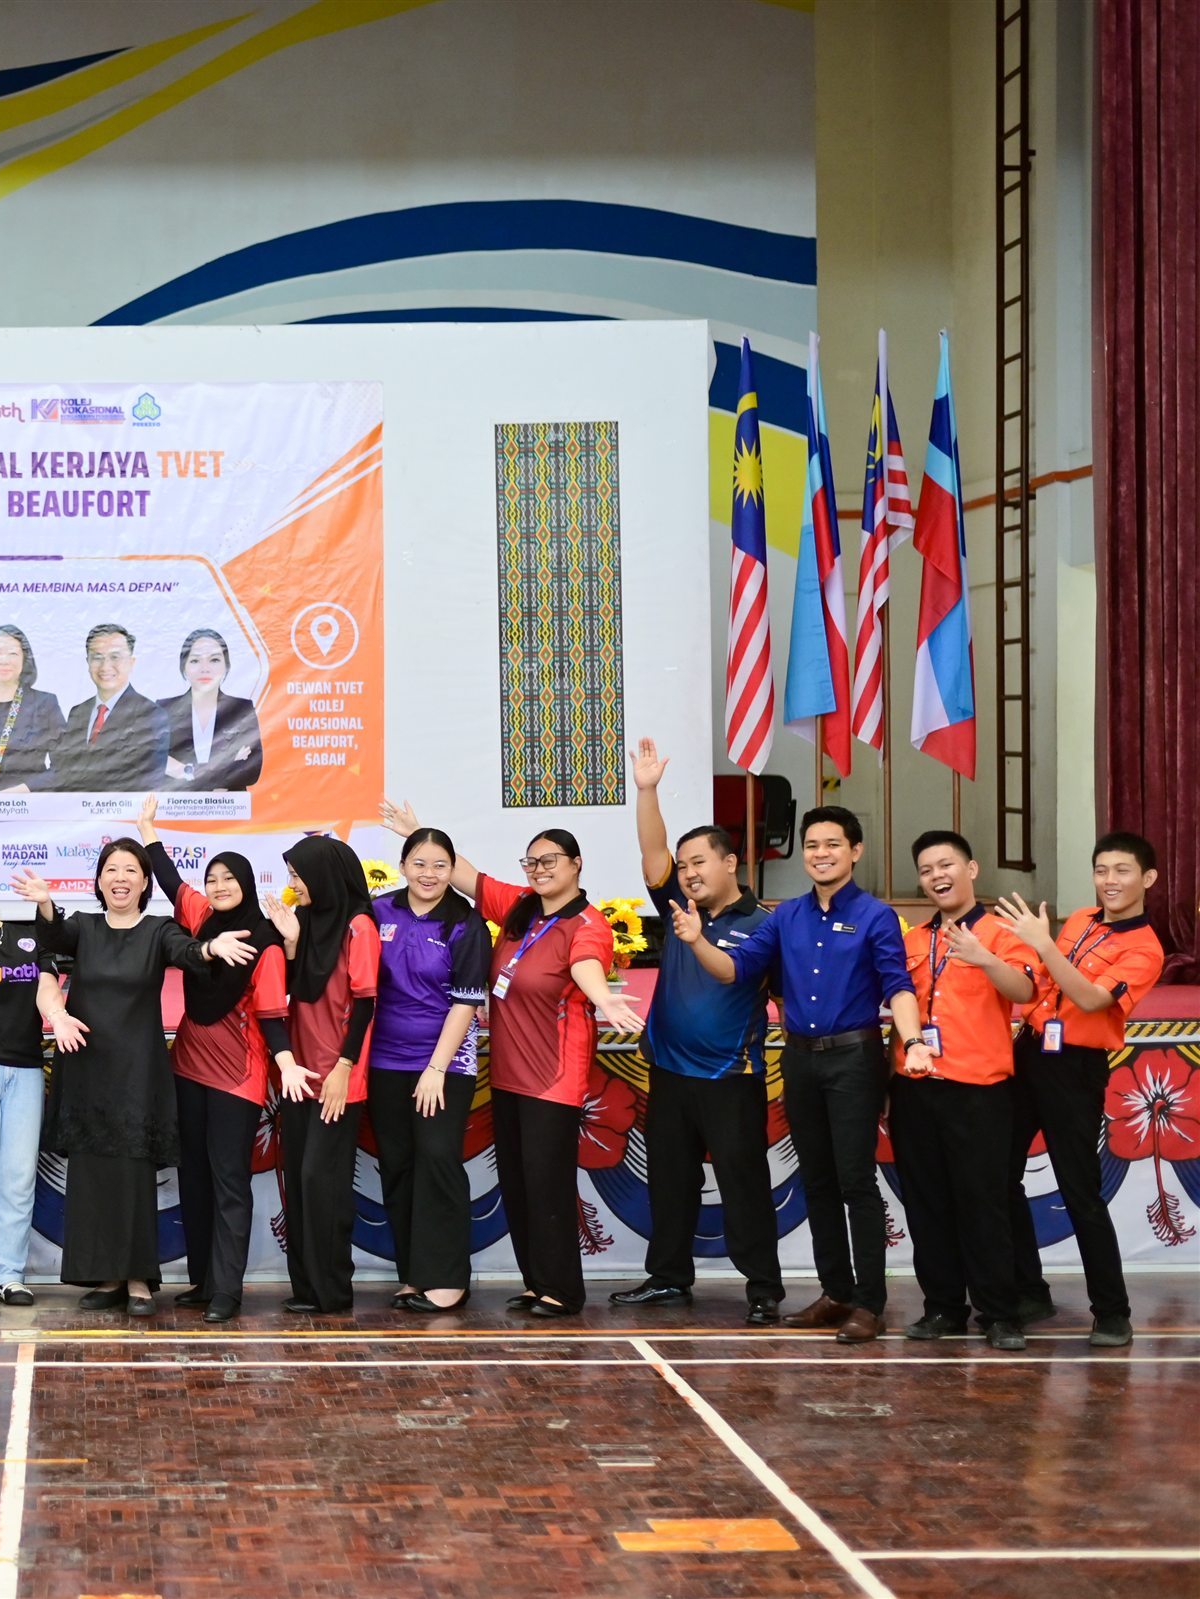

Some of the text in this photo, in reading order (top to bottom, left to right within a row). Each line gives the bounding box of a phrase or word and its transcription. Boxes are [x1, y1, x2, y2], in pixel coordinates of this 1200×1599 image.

[60, 398, 92, 406] KOLEJ
[60, 406, 125, 414] VOKASIONAL
[31, 451, 150, 478] KERJAYA
[157, 451, 225, 478] TVET
[7, 490, 151, 517] BEAUFORT
[23, 582, 84, 592] MEMBINA
[87, 582, 125, 592] MASA
[287, 681, 364, 694] DEWAN TVET
[309, 699, 345, 712] KOLEJ
[287, 717, 364, 730] VOKASIONAL
[292, 735, 358, 750] BEAUFORT,
[304, 752, 347, 766] SABAH
[0, 807, 29, 816] MyPath
[2, 851, 48, 859] MADANI
[175, 859, 199, 869] ANI
